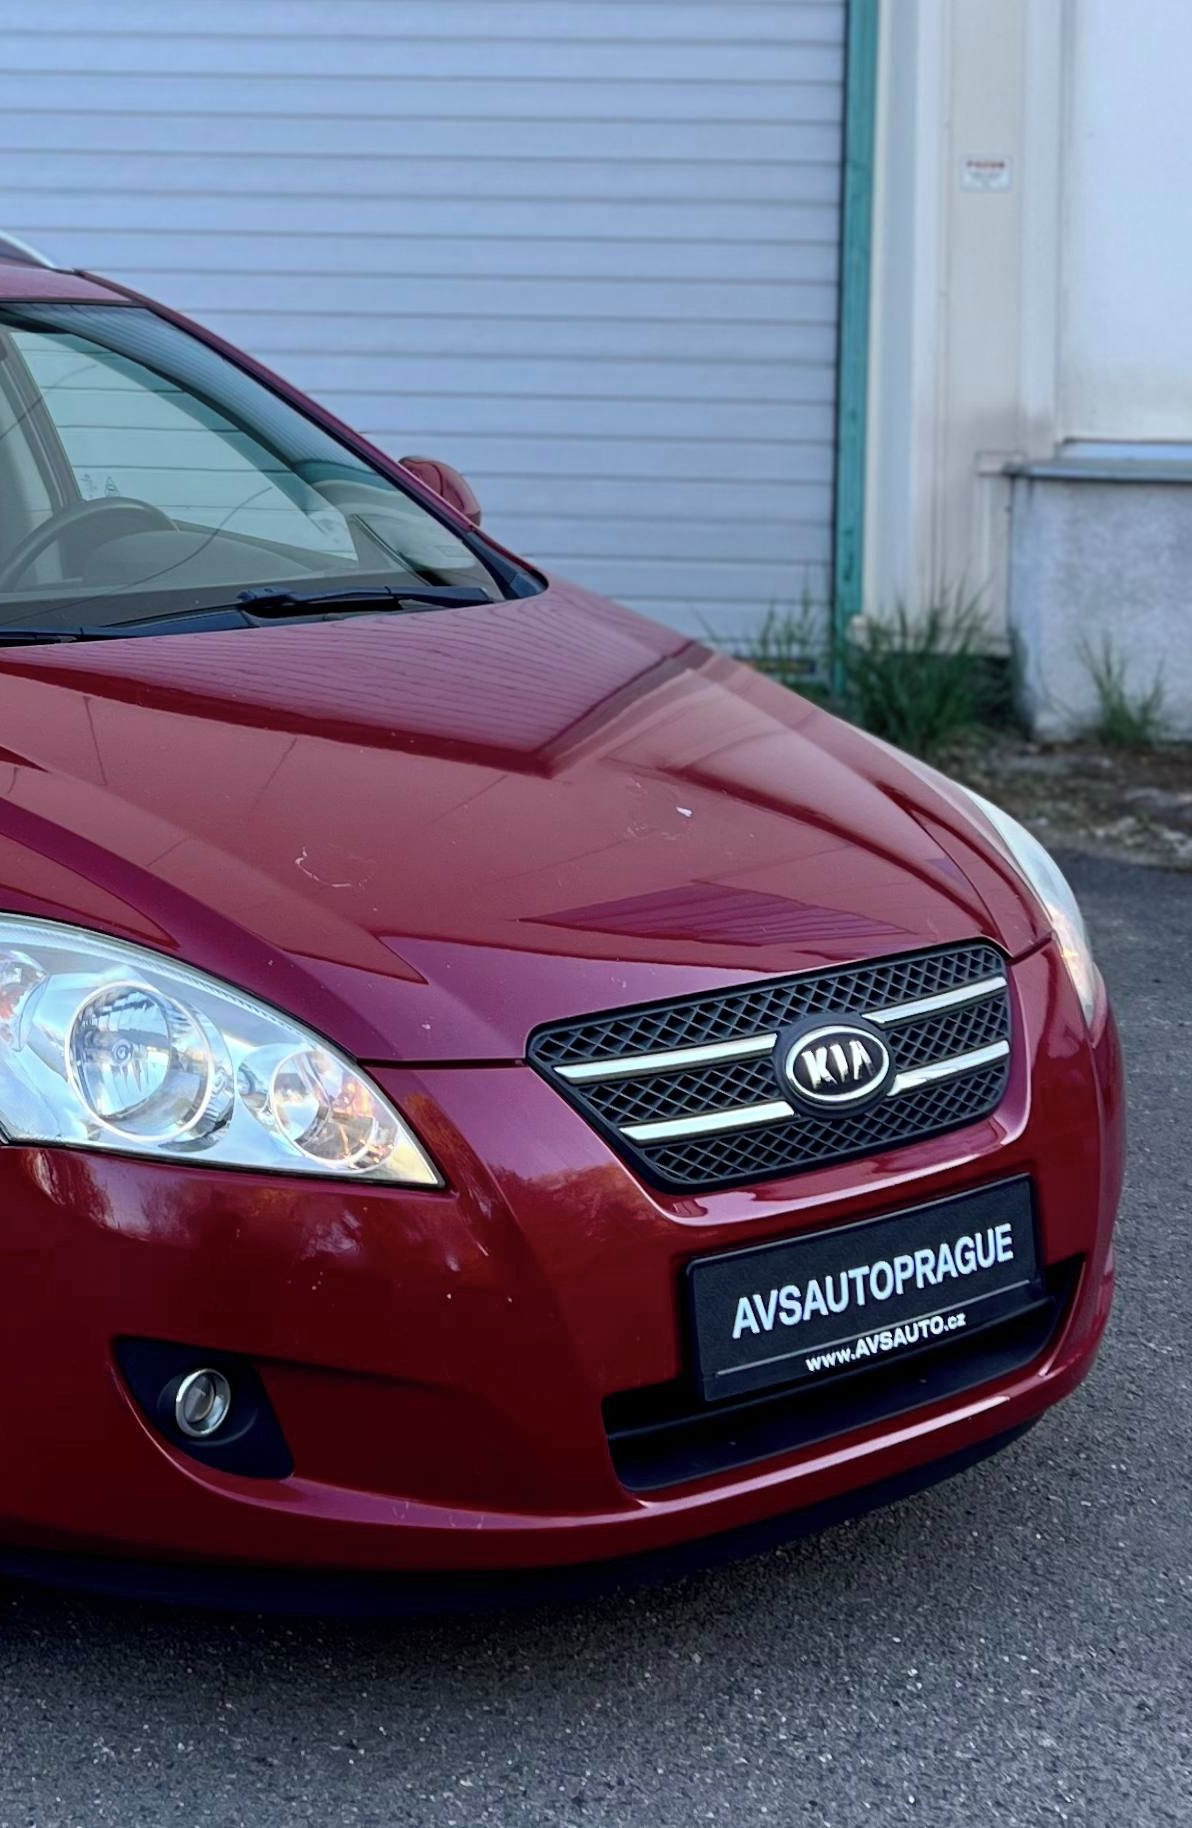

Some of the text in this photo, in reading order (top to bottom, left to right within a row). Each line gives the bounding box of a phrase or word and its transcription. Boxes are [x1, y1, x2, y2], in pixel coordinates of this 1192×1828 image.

[800, 1039, 876, 1089] KIA
[732, 1223, 1014, 1339] AVSAUTOPRAGUE
[805, 1312, 967, 1372] www.AVSAUTO.cz
